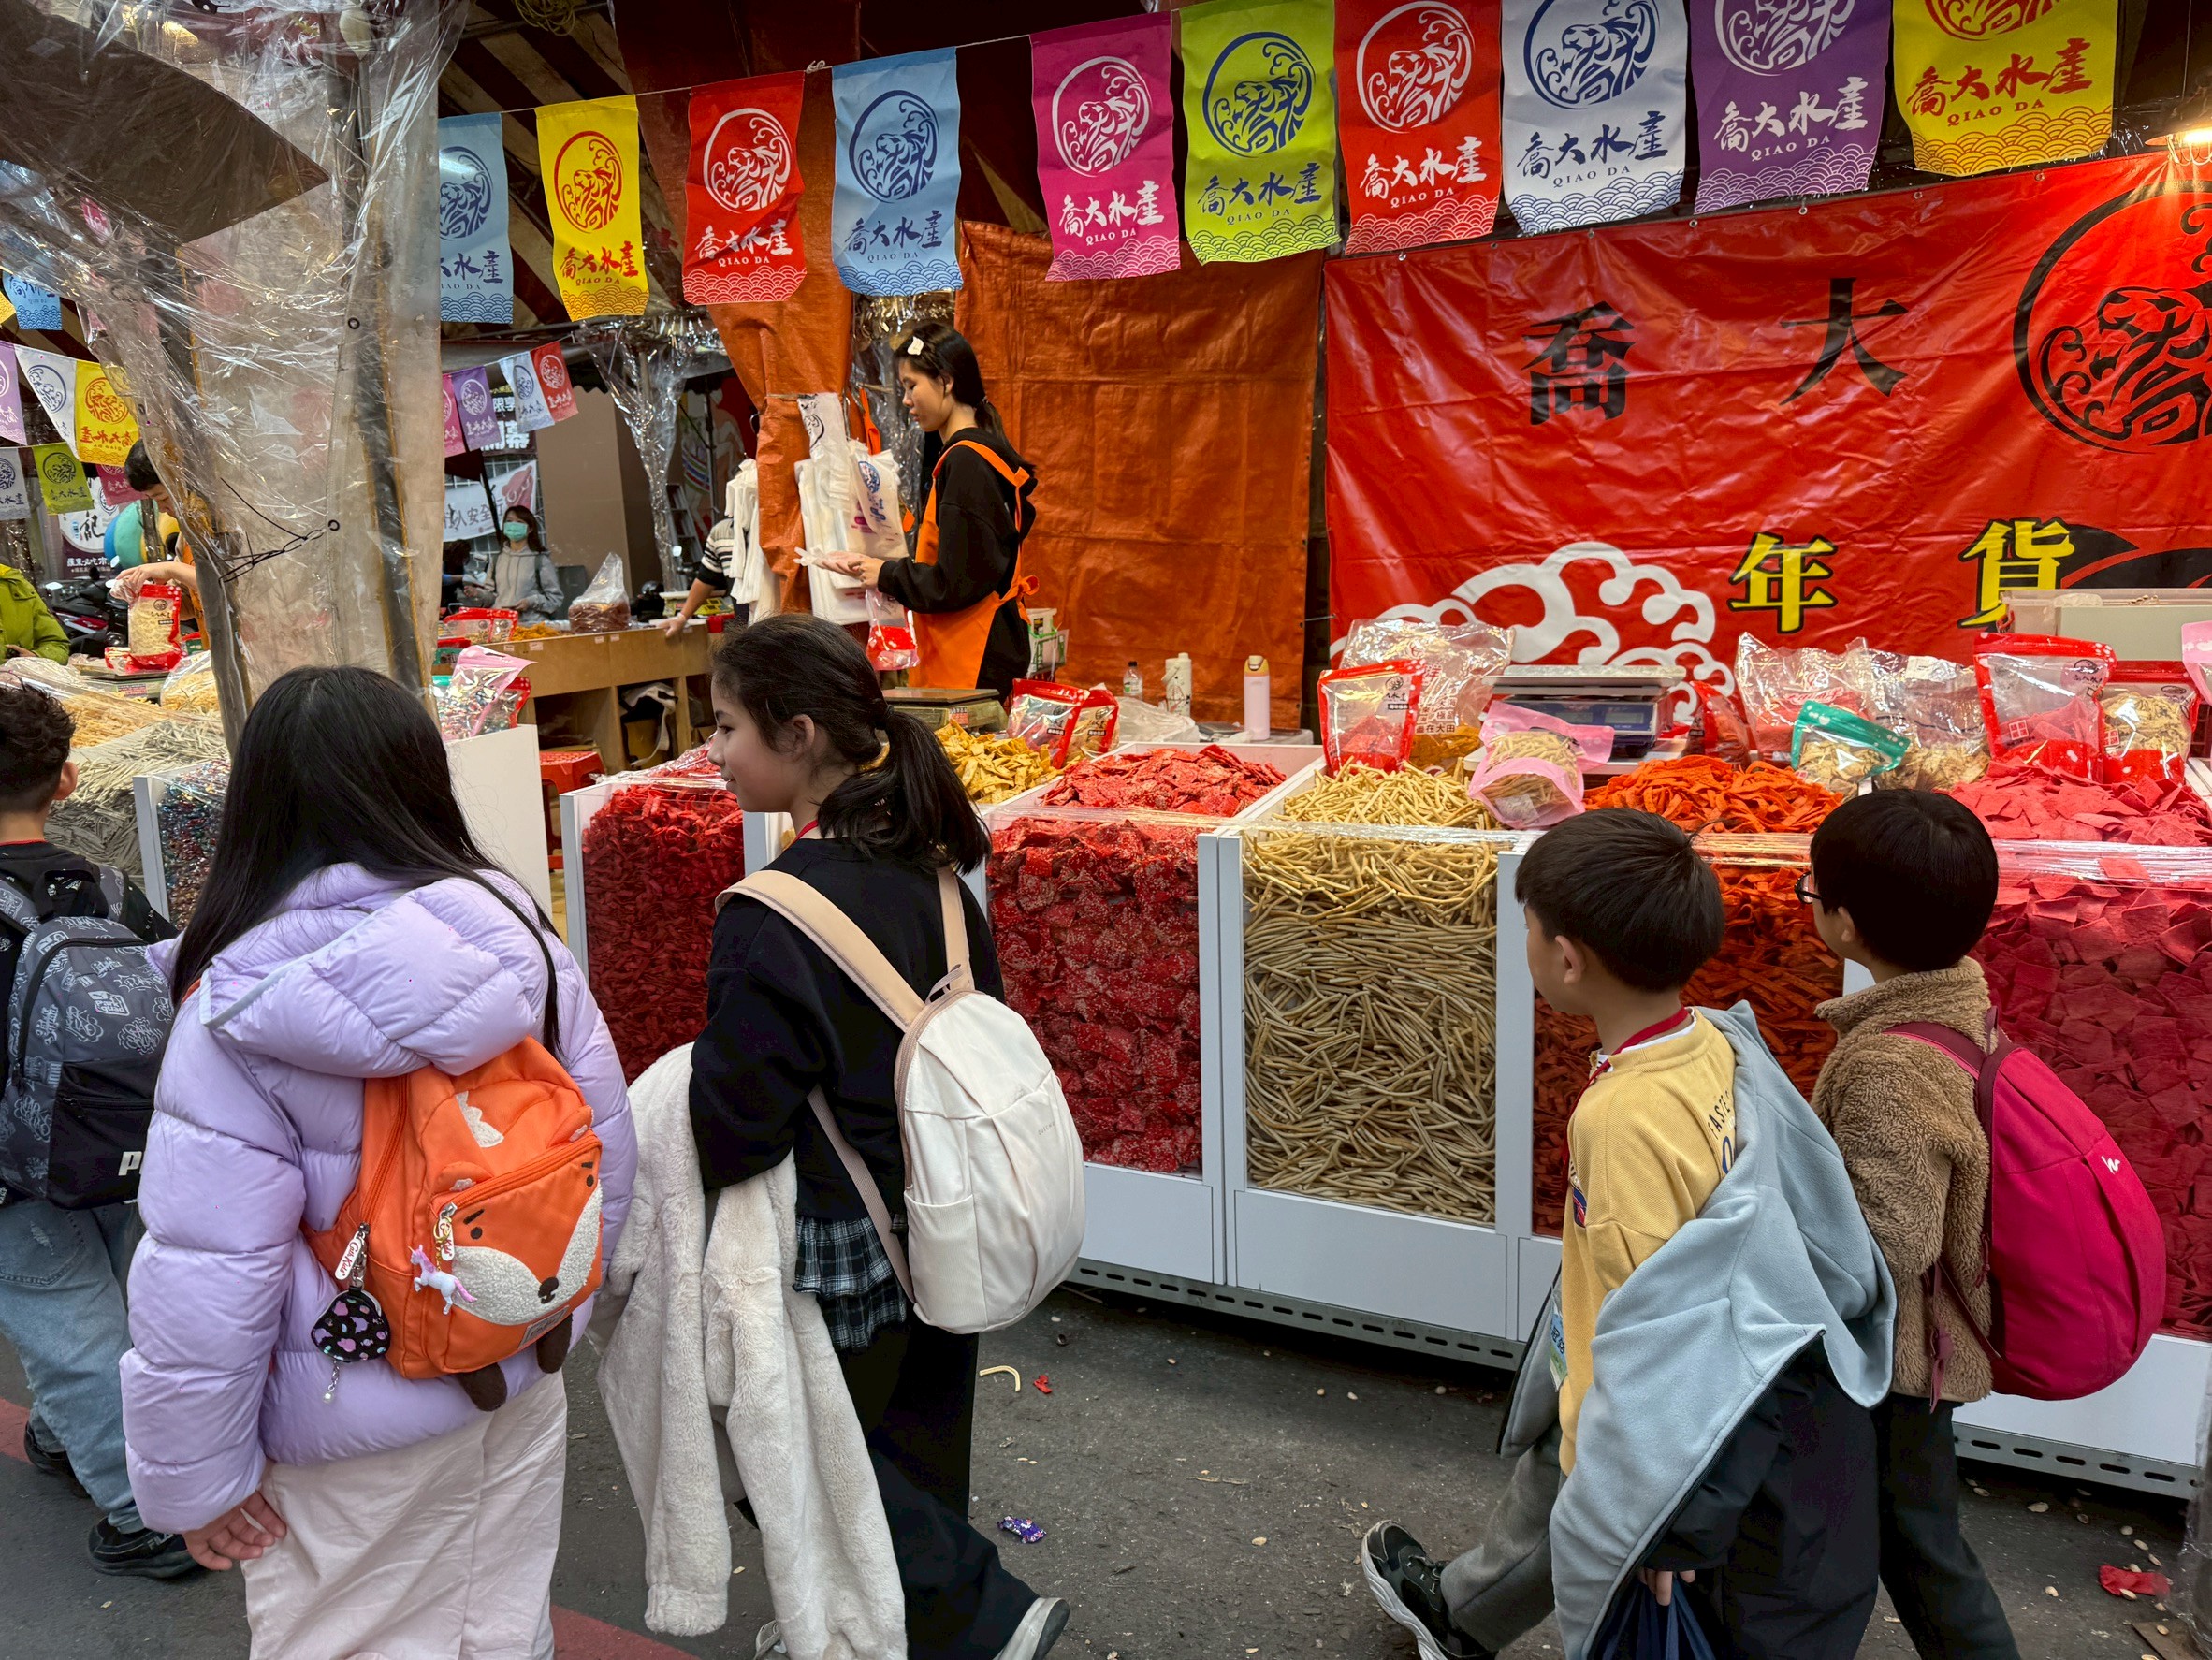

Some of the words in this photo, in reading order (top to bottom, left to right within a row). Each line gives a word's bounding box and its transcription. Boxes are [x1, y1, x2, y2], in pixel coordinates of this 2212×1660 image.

[1905, 36, 2093, 117] 喬大水產
[1713, 76, 1870, 152] 喬大水產
[1946, 105, 2002, 128] QIAO
[2014, 98, 2045, 112] DA
[1516, 110, 1669, 180] 喬大水產
[1751, 141, 1797, 162] QIAO
[1807, 135, 1831, 149] DA
[1359, 136, 1487, 199] 喬大水產
[1552, 170, 1596, 188] QIAO
[1608, 165, 1631, 177] DA
[1198, 162, 1322, 216] 喬大水產
[1390, 192, 1427, 209] QIAO
[1434, 187, 1455, 198] DA
[1058, 180, 1165, 238] 喬大水產
[1227, 211, 1264, 226] QIAO
[1272, 209, 1291, 218] DA
[694, 219, 793, 260] 喬大水產
[845, 210, 943, 255] 喬大水產
[1085, 232, 1117, 247] QIAO
[1122, 228, 1137, 238] DA
[560, 240, 639, 280] 喬大水產
[718, 257, 749, 268] QIAO
[754, 255, 771, 265] DA
[866, 253, 897, 264] QIAO
[904, 252, 919, 260] DA
[575, 277, 601, 287] QIAO
[605, 276, 620, 284] DA
[118, 1151, 143, 1176] P
